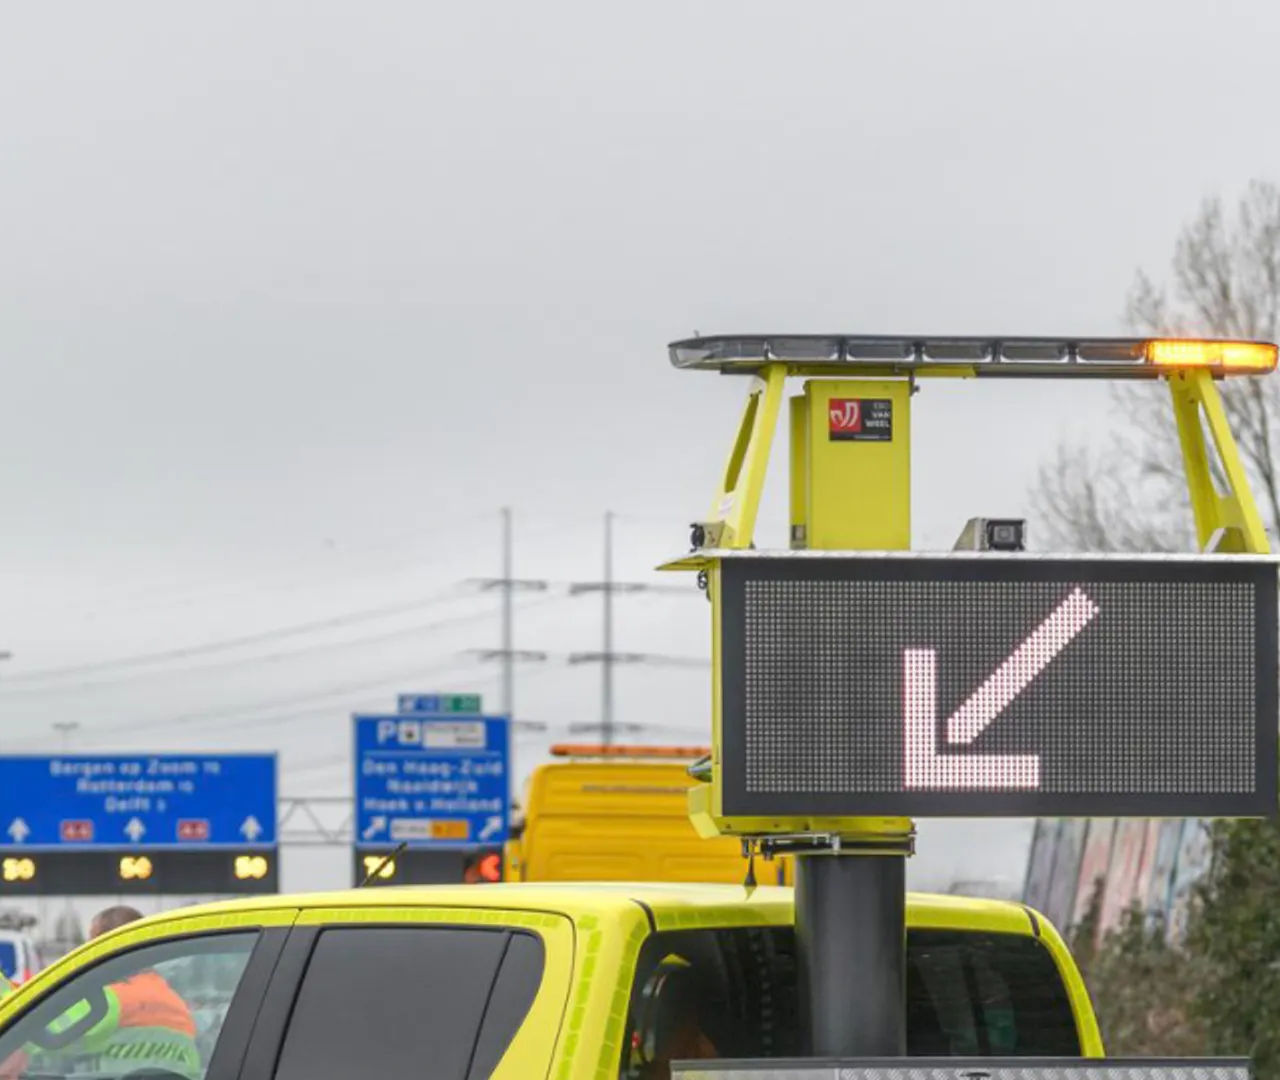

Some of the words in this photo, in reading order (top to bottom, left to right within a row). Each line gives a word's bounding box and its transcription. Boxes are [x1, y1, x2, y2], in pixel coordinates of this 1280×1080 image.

[49, 760, 115, 778] Bergen
[119, 762, 141, 777] op
[146, 758, 197, 775] Zoom
[362, 758, 397, 776] Den
[403, 758, 503, 779] Haag-Zuid
[76, 778, 175, 794] Rotterdam
[104, 796, 150, 813] Delft
[363, 797, 408, 812] Hoek
[430, 797, 503, 812] Holland
